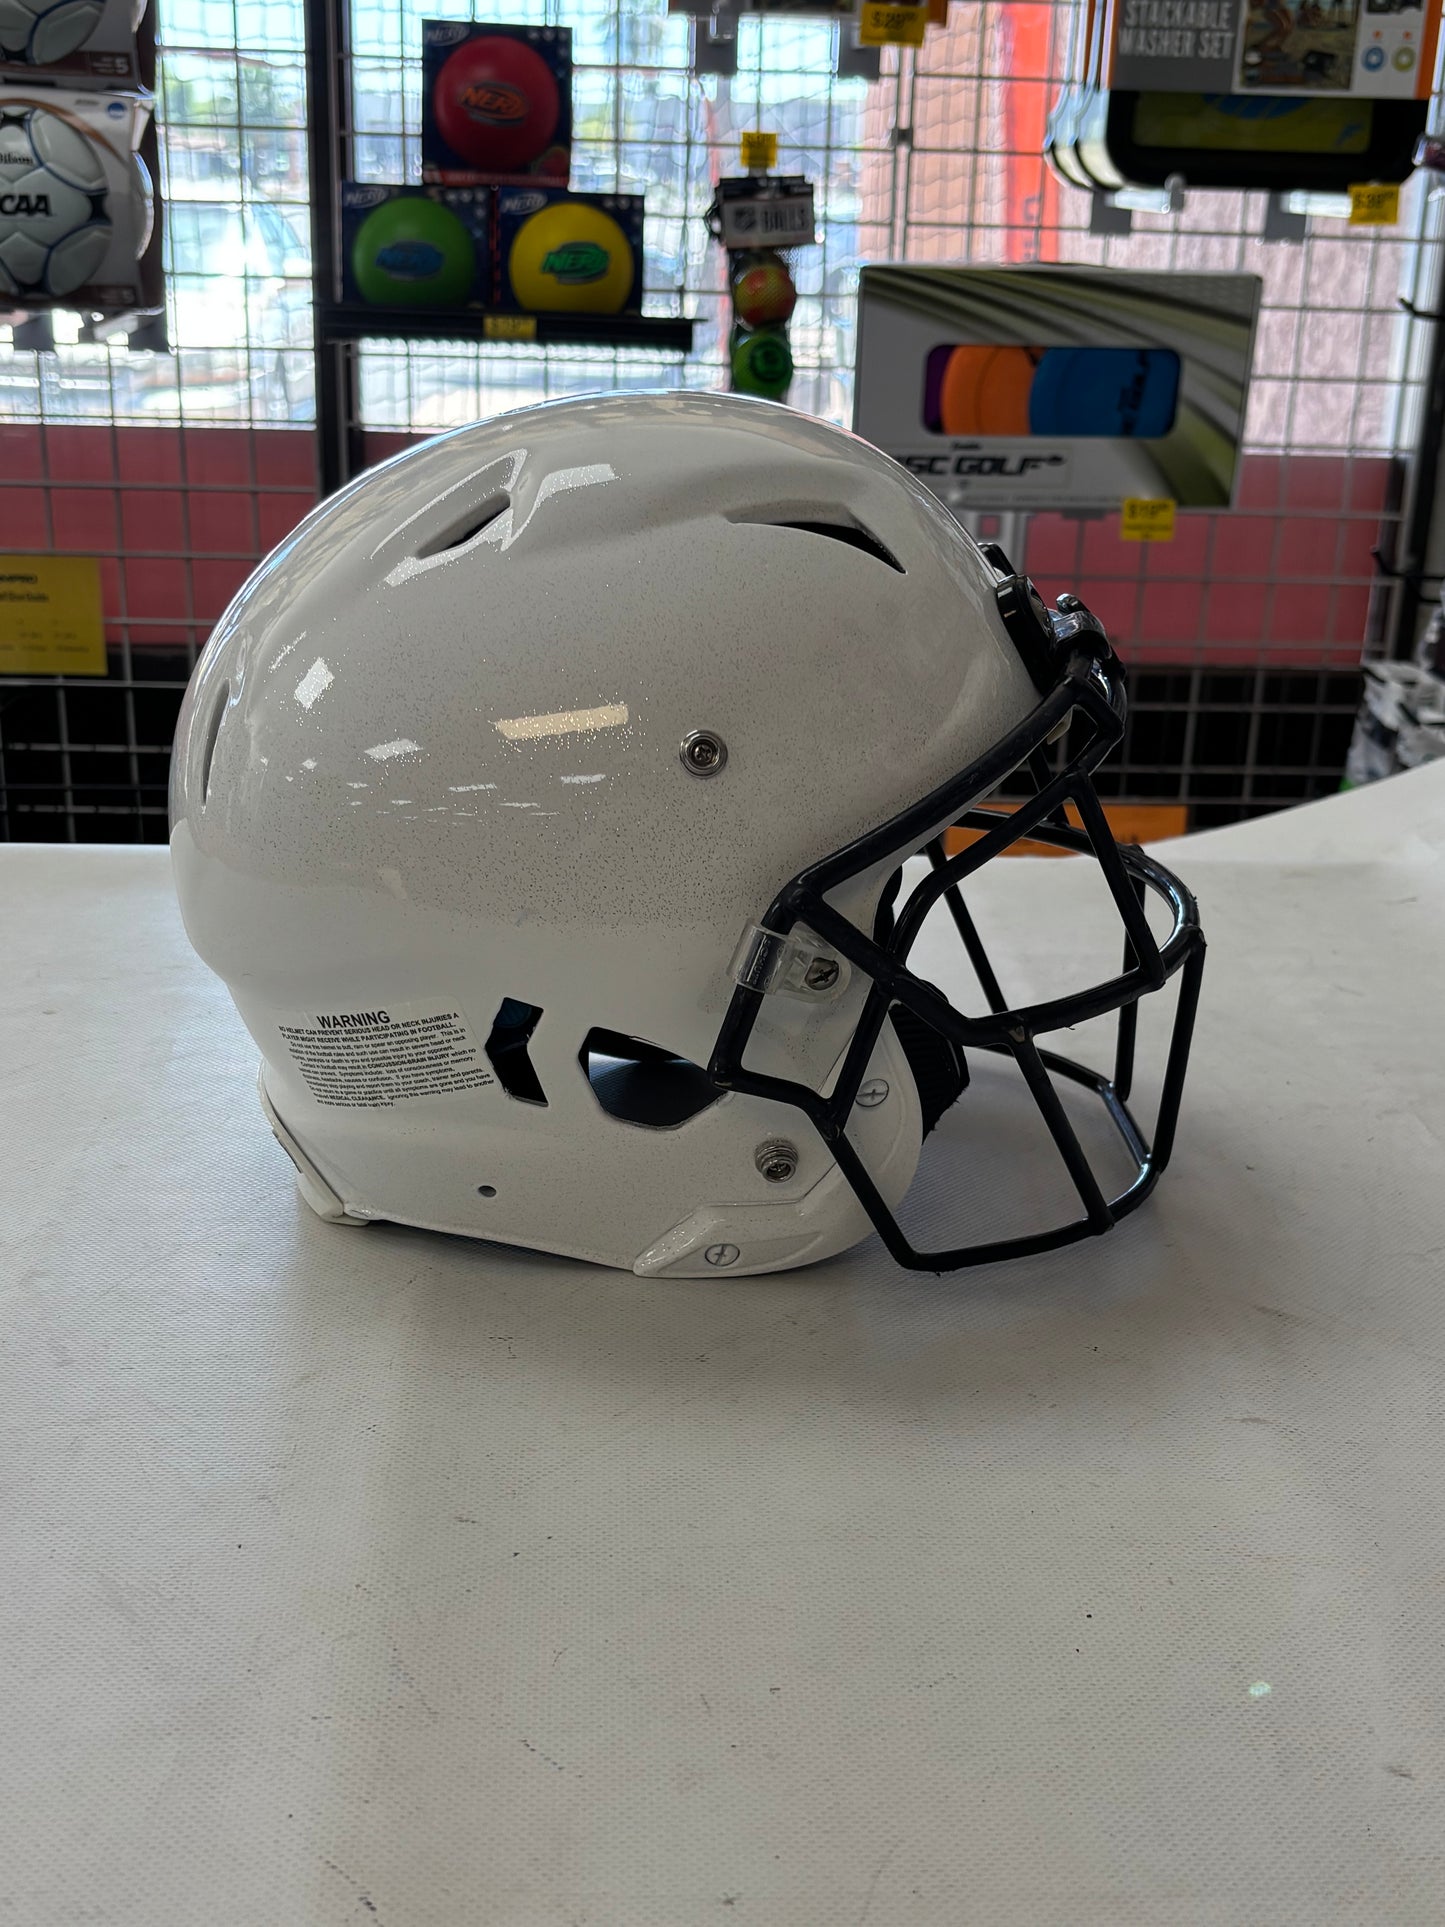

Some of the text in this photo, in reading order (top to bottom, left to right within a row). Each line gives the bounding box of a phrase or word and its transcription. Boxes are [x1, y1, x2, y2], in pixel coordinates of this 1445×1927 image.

[1124, 0, 1232, 29] STACKABLE
[1119, 27, 1235, 59] WASHER SET
[0, 195, 51, 217] CAA
[954, 455, 1043, 476] GOLF
[316, 1010, 390, 1029] WARNING
[344, 1027, 371, 1035] SERIOUS
[421, 1014, 452, 1024] INJURIES
[361, 1030, 409, 1041] PARTICIPATING
[418, 1022, 456, 1033] FOOTBALL.
[427, 1052, 450, 1061] INJURY
[404, 1062, 443, 1071] consciousness
[402, 1084, 428, 1092] symptoms
[438, 1080, 453, 1088] gone
[474, 1079, 494, 1088] another
